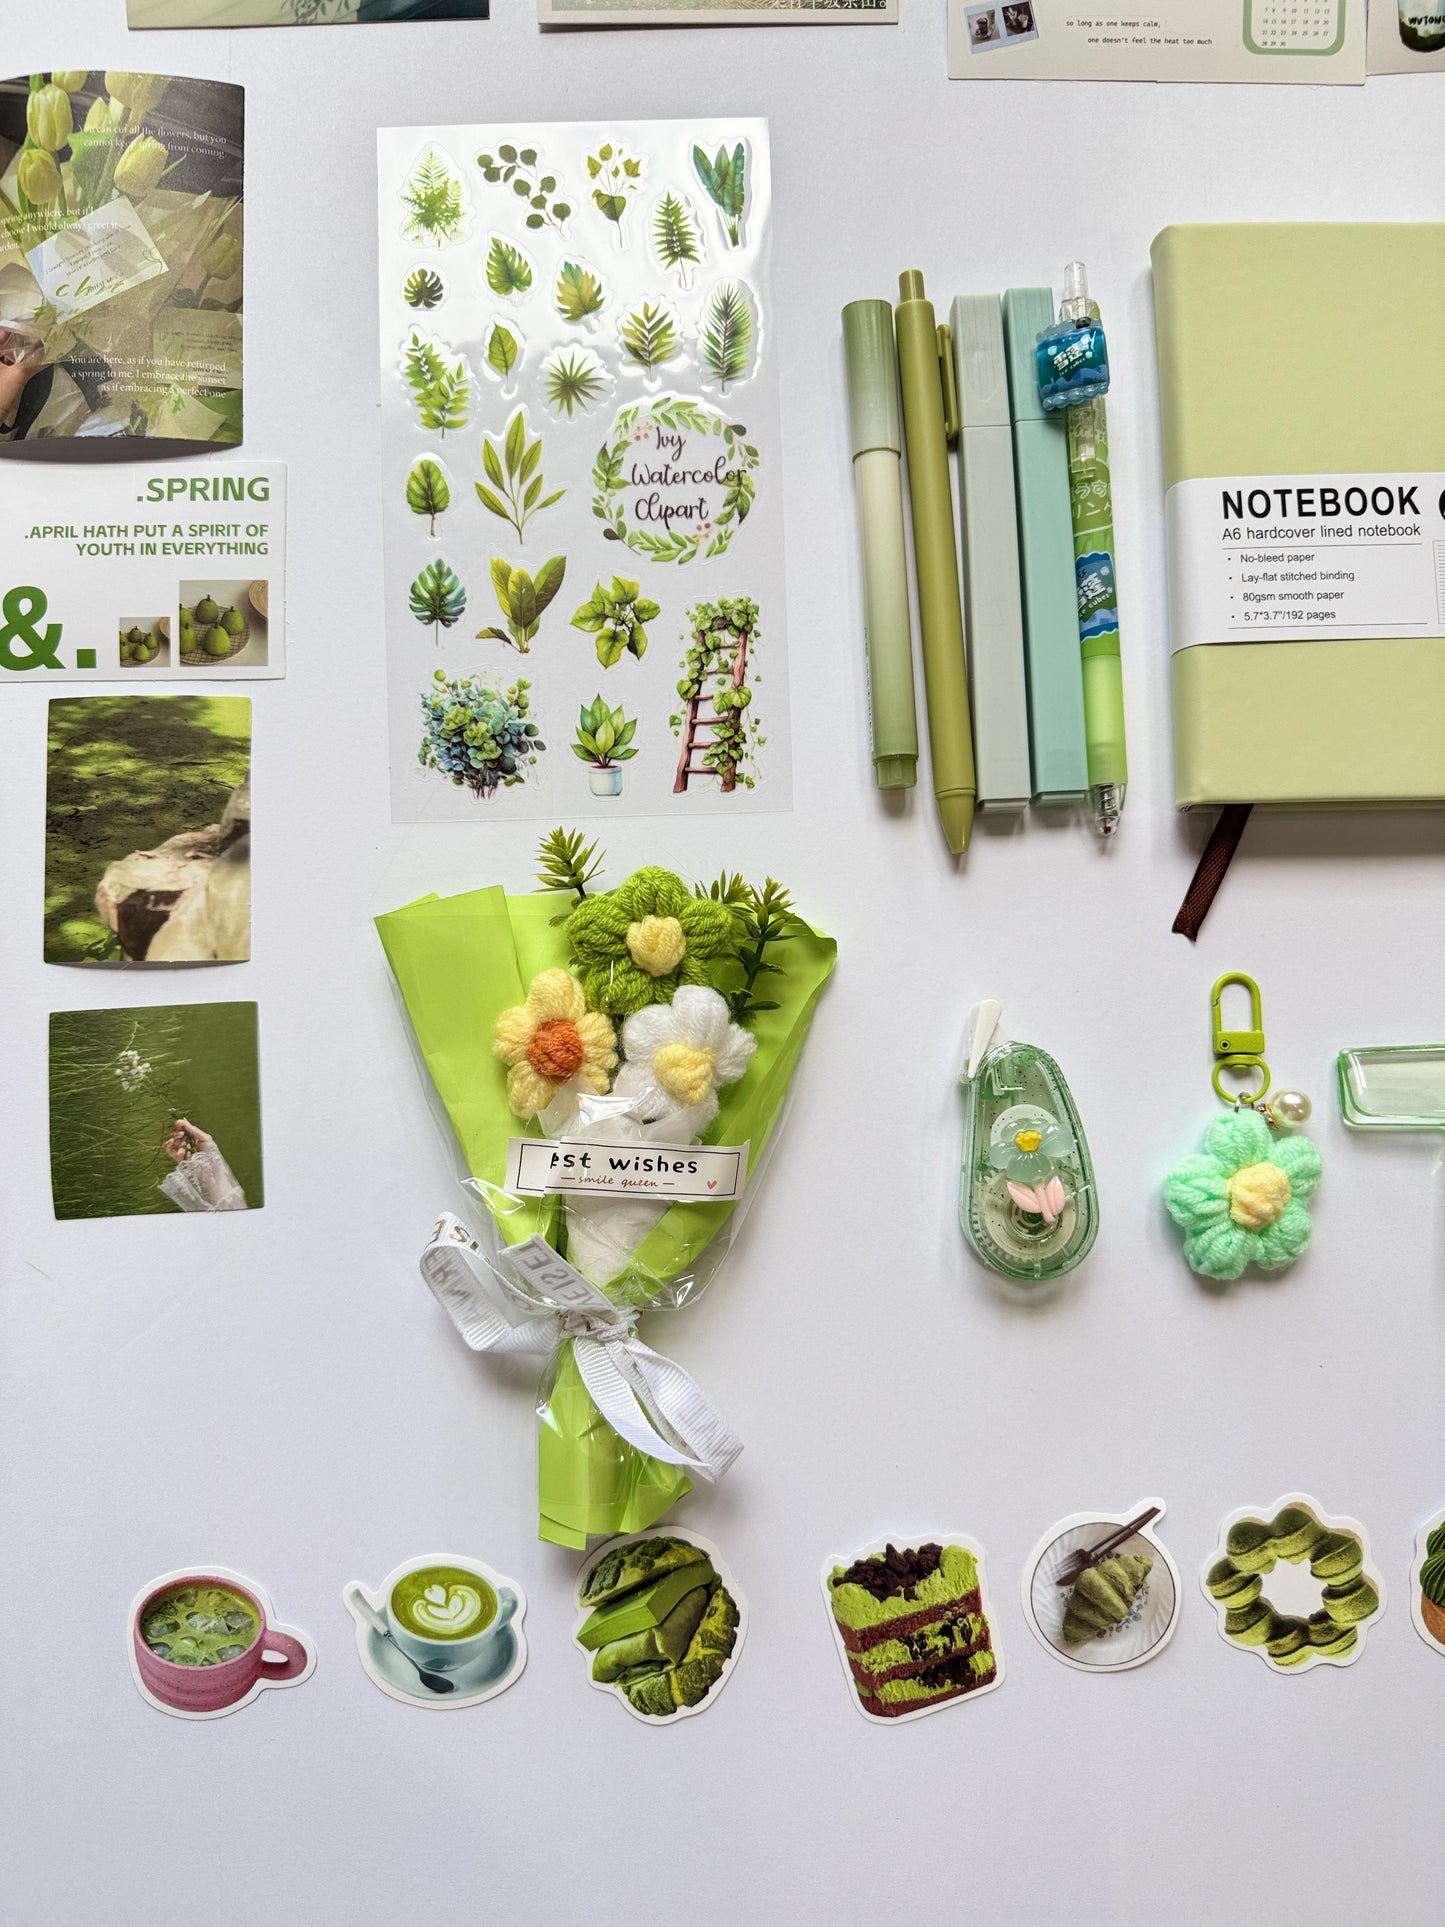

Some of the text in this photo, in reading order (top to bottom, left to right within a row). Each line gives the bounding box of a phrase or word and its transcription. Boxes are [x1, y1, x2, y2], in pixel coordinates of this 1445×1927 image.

[1077, 20, 1092, 28] long
[1121, 20, 1140, 28] keeps
[1142, 20, 1161, 28] calm,
[130, 124, 140, 134] all
[194, 131, 209, 142] but
[210, 135, 227, 145] you
[168, 142, 189, 152] from
[66, 206, 80, 216] but
[27, 223, 30, 233] I
[32, 221, 58, 232] would
[70, 355, 86, 364] You
[88, 356, 101, 365] are
[104, 355, 124, 366] here,
[138, 356, 146, 365] if
[146, 359, 163, 369] you
[164, 358, 186, 368] have
[187, 360, 226, 372] returned
[78, 370, 106, 382] spring
[108, 370, 117, 378] to
[142, 370, 182, 381] embrace
[182, 372, 197, 382] the
[198, 374, 226, 385] sunset
[112, 383, 120, 392] if
[120, 383, 168, 396] embracing
[176, 385, 208, 398] perfect
[209, 391, 226, 399] one
[656, 426, 687, 462] Ivy
[632, 456, 748, 486] Watercolor
[136, 477, 270, 502] .SPRING
[1222, 486, 1421, 520] NOTEBOOK
[635, 492, 709, 531] Clipart
[24, 524, 269, 539] .APRIL HATH PUT A SPIRIT OF
[1222, 524, 1421, 541] A6 hardcover lined notebook
[76, 542, 269, 556] YOUTH IN EVERYTHING
[1240, 553, 1315, 565] No-bleed paper
[1241, 571, 1355, 583] Lay-flat stitched binding
[1242, 591, 1345, 603] 80gsm smooth paper
[1306, 610, 1336, 622] pages
[608, 1154, 698, 1174] wishes
[578, 1175, 660, 1188] smile queen
